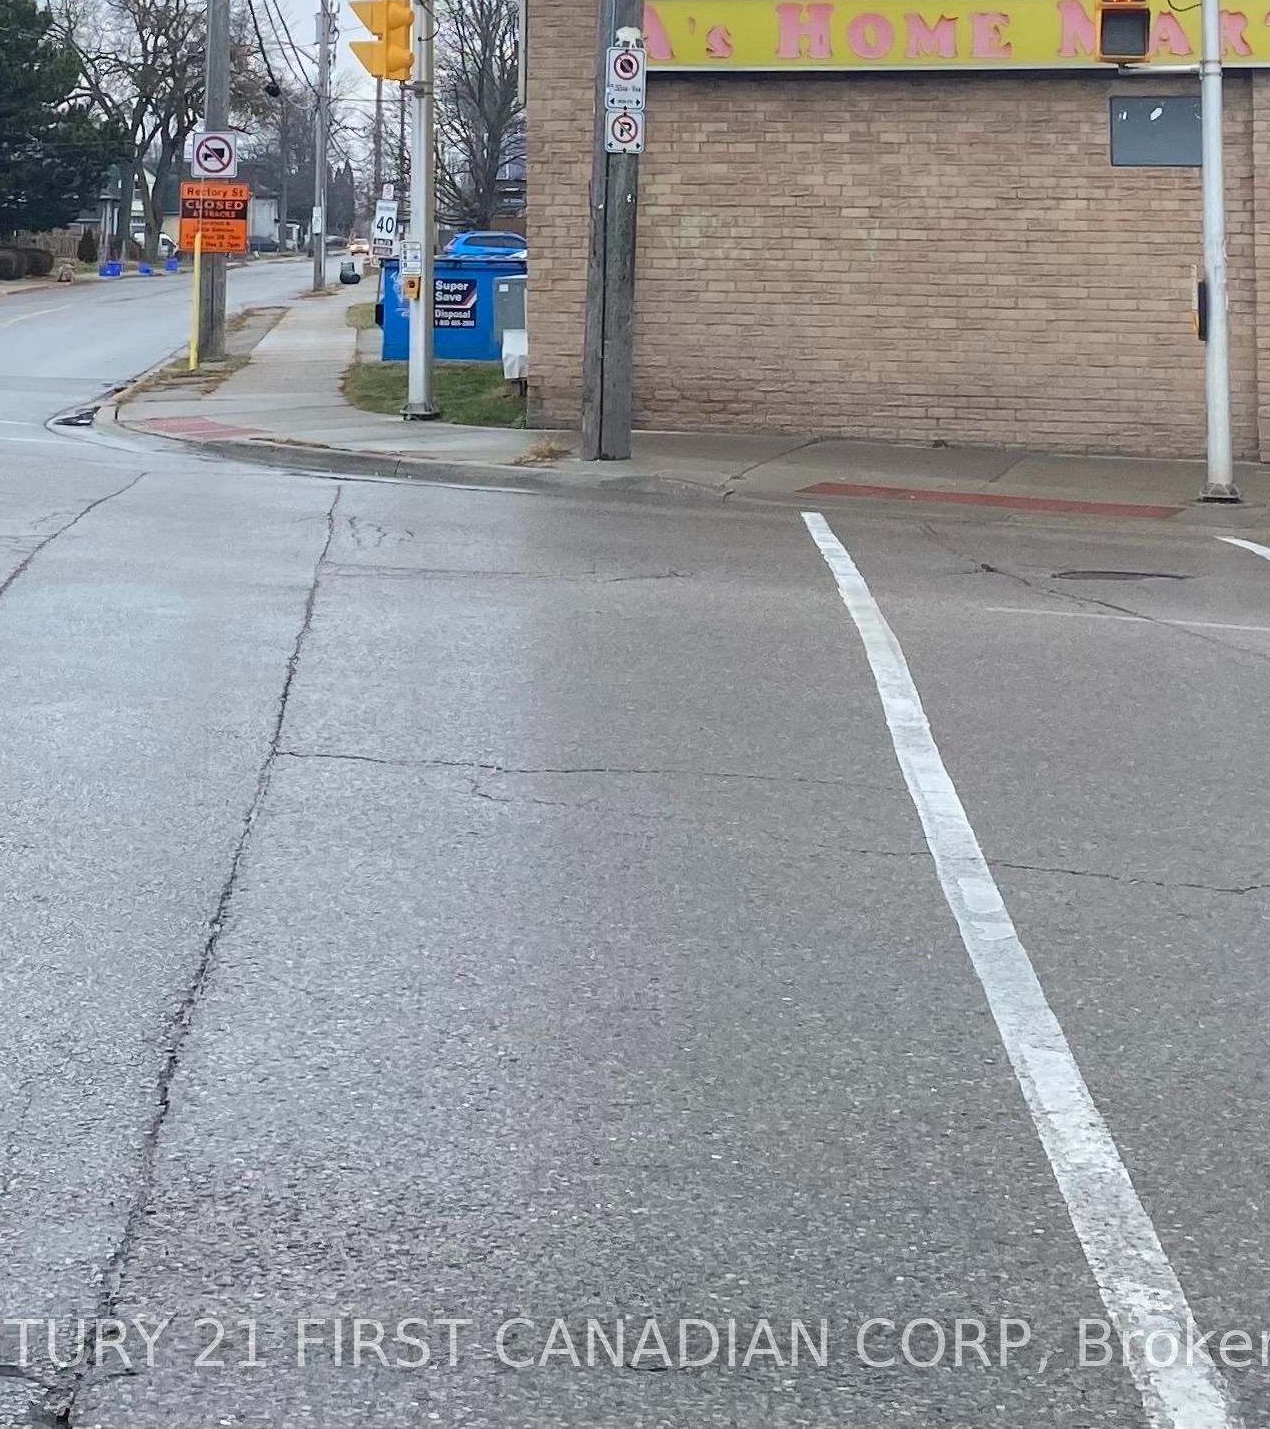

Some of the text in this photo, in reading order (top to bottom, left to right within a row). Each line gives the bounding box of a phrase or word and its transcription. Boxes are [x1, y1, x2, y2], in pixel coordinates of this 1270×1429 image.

[775, 2, 1012, 59] HOME
[187, 187, 244, 198] Rectory St
[186, 200, 244, 210] CLOSED
[376, 216, 394, 234] 40
[435, 280, 469, 292] Super
[435, 292, 463, 302] Save
[434, 309, 471, 319] Disposal
